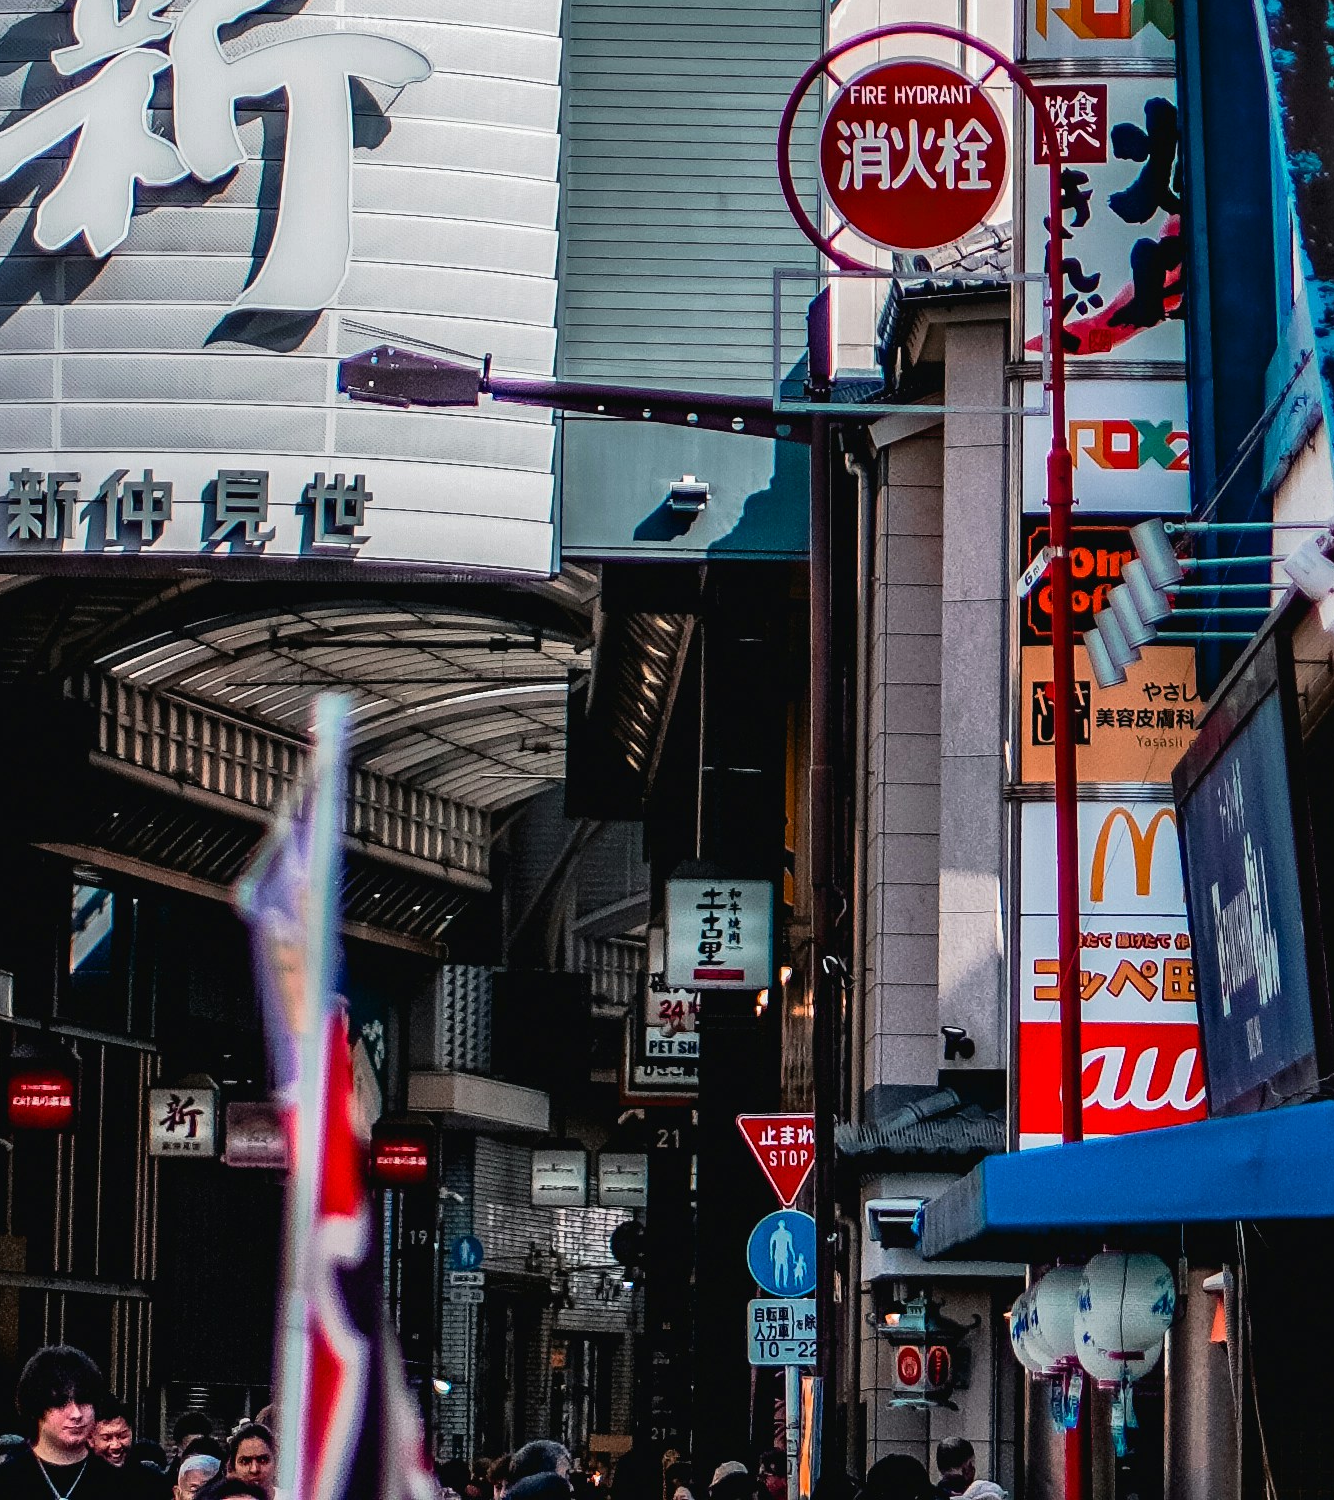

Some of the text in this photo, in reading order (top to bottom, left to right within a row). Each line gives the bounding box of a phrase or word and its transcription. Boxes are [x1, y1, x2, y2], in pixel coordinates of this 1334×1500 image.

[850, 84, 974, 105] FIRE HYDRANT
[836, 118, 993, 190] 消火栓
[6, 467, 374, 548] 新仲見世
[1096, 708, 1195, 730] 美容皮膚科
[695, 887, 728, 966] 土古里
[728, 887, 743, 945] 和牛焼肉
[649, 1039, 676, 1054] PET
[1060, 1046, 1206, 1111] au
[159, 1093, 205, 1138] 新
[656, 1128, 681, 1149] 21
[758, 1124, 815, 1146] 止まれ
[769, 1149, 809, 1167] STOP
[410, 1229, 428, 1245] 19
[755, 1306, 790, 1323] 自転車
[754, 1322, 790, 1340] 人力車
